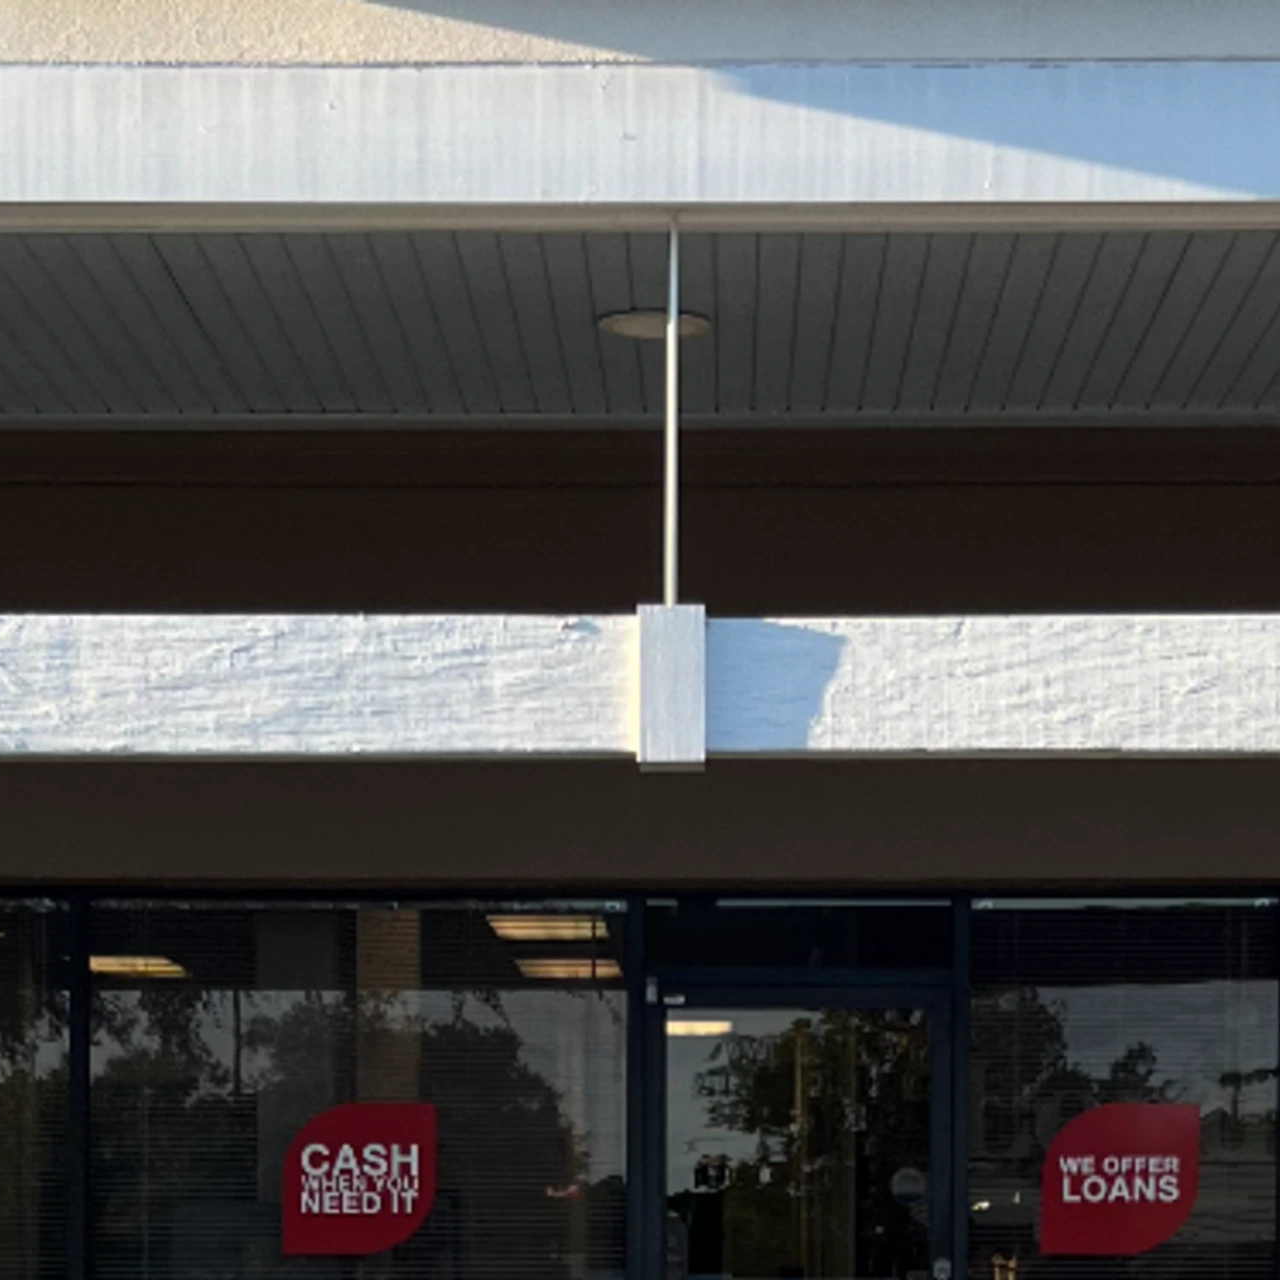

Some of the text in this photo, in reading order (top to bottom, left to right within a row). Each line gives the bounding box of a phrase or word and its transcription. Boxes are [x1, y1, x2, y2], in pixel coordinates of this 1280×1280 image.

[300, 1143, 419, 1176] CASH
[1059, 1156, 1180, 1175] WE OFFER
[300, 1174, 419, 1192] WHEN YOU
[1062, 1175, 1180, 1203] LOANS
[300, 1191, 419, 1214] NEED IT
